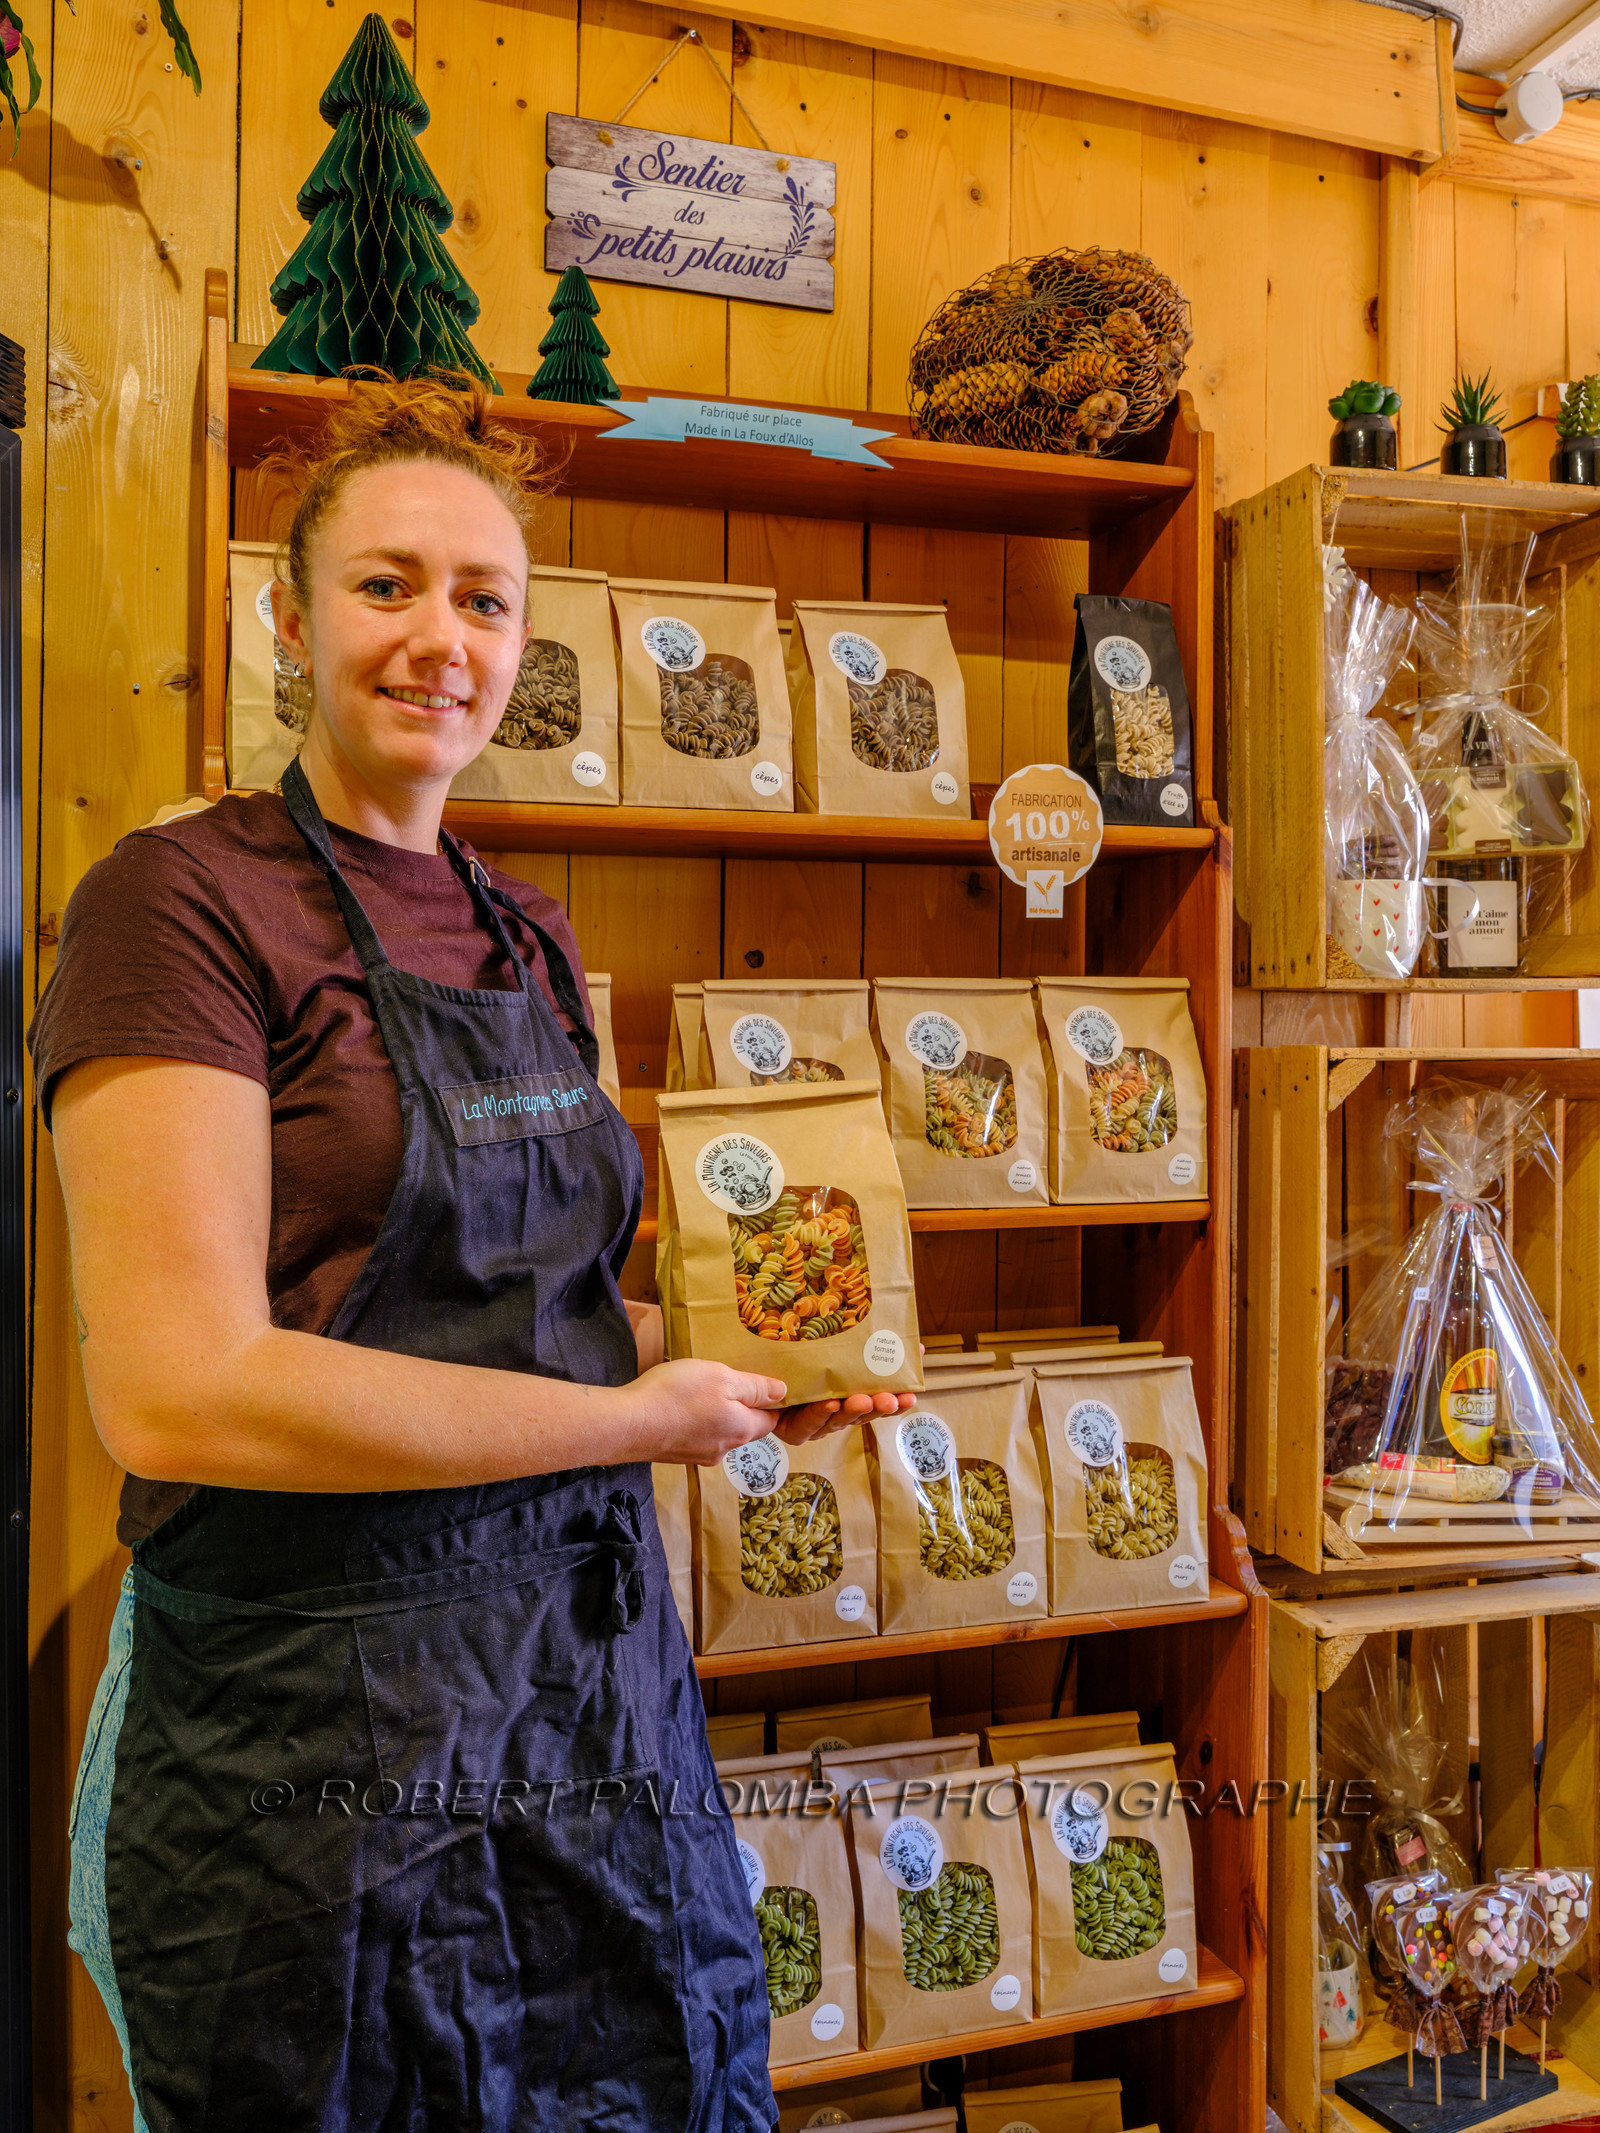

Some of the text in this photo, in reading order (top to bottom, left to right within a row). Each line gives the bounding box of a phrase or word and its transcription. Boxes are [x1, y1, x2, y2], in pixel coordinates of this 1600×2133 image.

[638, 140, 746, 195] Sentier
[674, 201, 704, 225] des
[576, 225, 788, 281] petits plaisirs
[700, 405, 802, 427] Fabriqué sur place
[685, 422, 814, 447] Made in La Foux d'Allos
[576, 761, 601, 775] cèpes
[755, 771, 778, 785] cèpes
[935, 780, 955, 794] cèpes
[1011, 793, 1082, 808] FABRICATION
[1005, 809, 1090, 842] 100%
[1011, 847, 1081, 862] artisanale
[1478, 910, 1508, 918] t'aime
[736, 1045, 745, 1054] LA
[752, 1019, 764, 1027] DES
[764, 1020, 786, 1043] SAVEURS
[461, 1098, 483, 1120] La
[702, 1137, 772, 1194] LA MONTAGNE DES SAVEURS
[876, 1337, 896, 1346] nature
[874, 1345, 896, 1355] tomate
[871, 1353, 895, 1364] épinard
[916, 1417, 927, 1426] DES
[928, 1417, 949, 1441] SAVEURS
[1071, 1437, 1080, 1447] LA
[729, 1464, 739, 1474] LA
[1056, 1830, 1066, 1841] LA
[885, 1859, 896, 1870] LA
[903, 1821, 914, 1832] DES
[914, 1821, 936, 1847] SAVEURS
